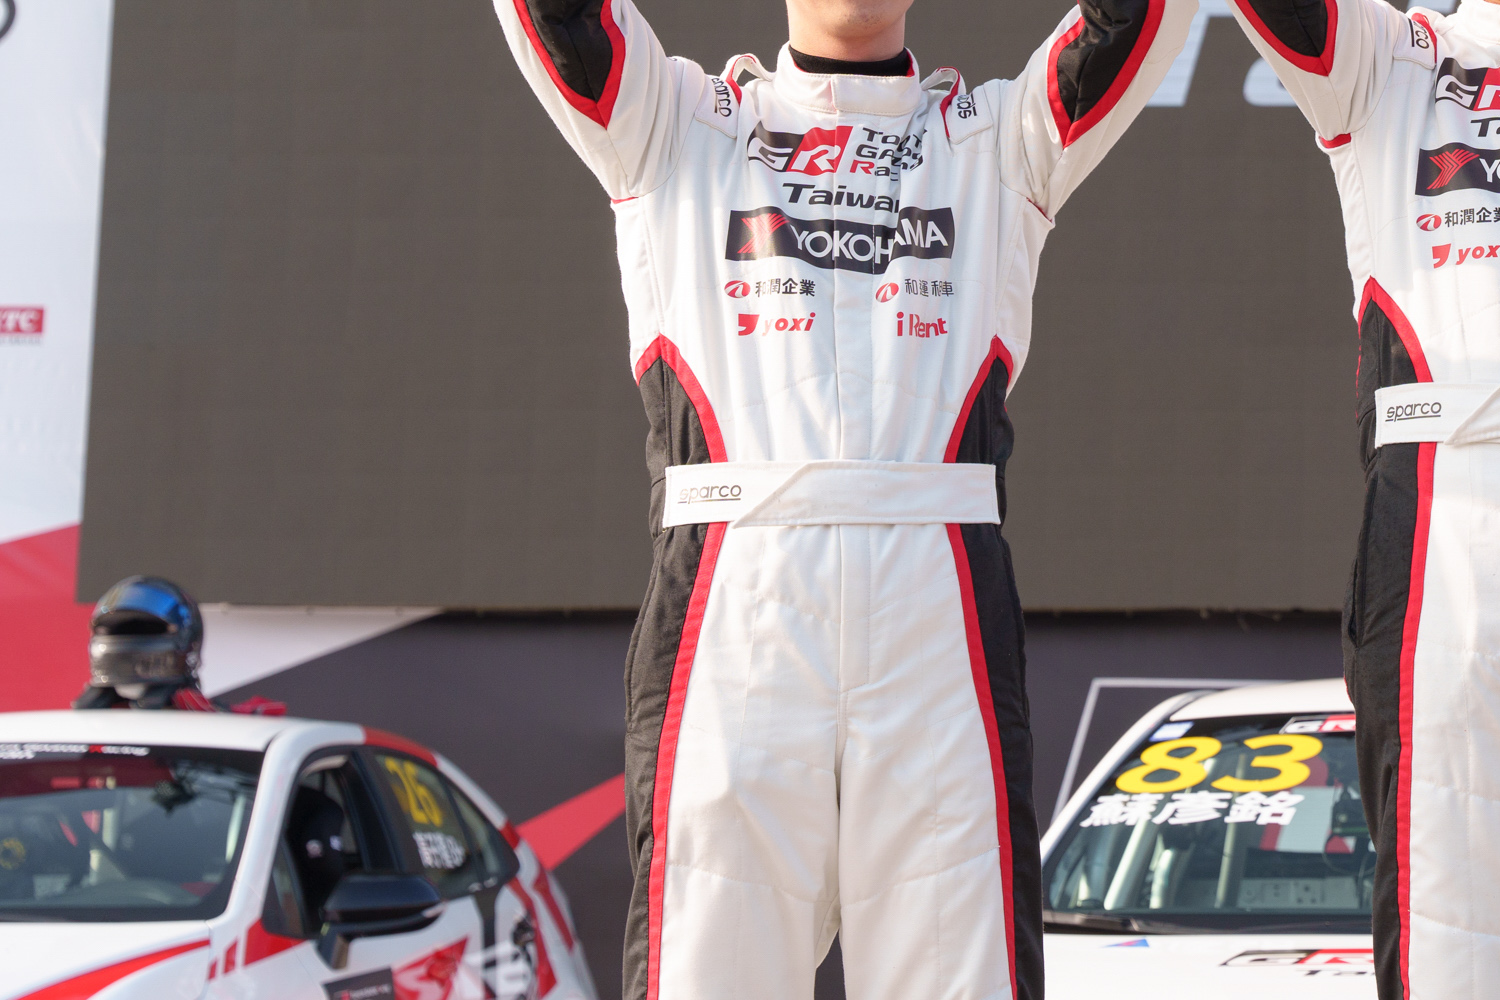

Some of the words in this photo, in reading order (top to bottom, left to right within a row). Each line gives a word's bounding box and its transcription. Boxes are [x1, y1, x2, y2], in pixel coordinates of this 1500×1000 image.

[747, 137, 841, 172] GR
[755, 278, 816, 297] 和潤企業
[762, 312, 816, 336] yoxi
[1385, 402, 1442, 422] sparco
[678, 484, 742, 504] sparco
[1116, 735, 1323, 794] 83
